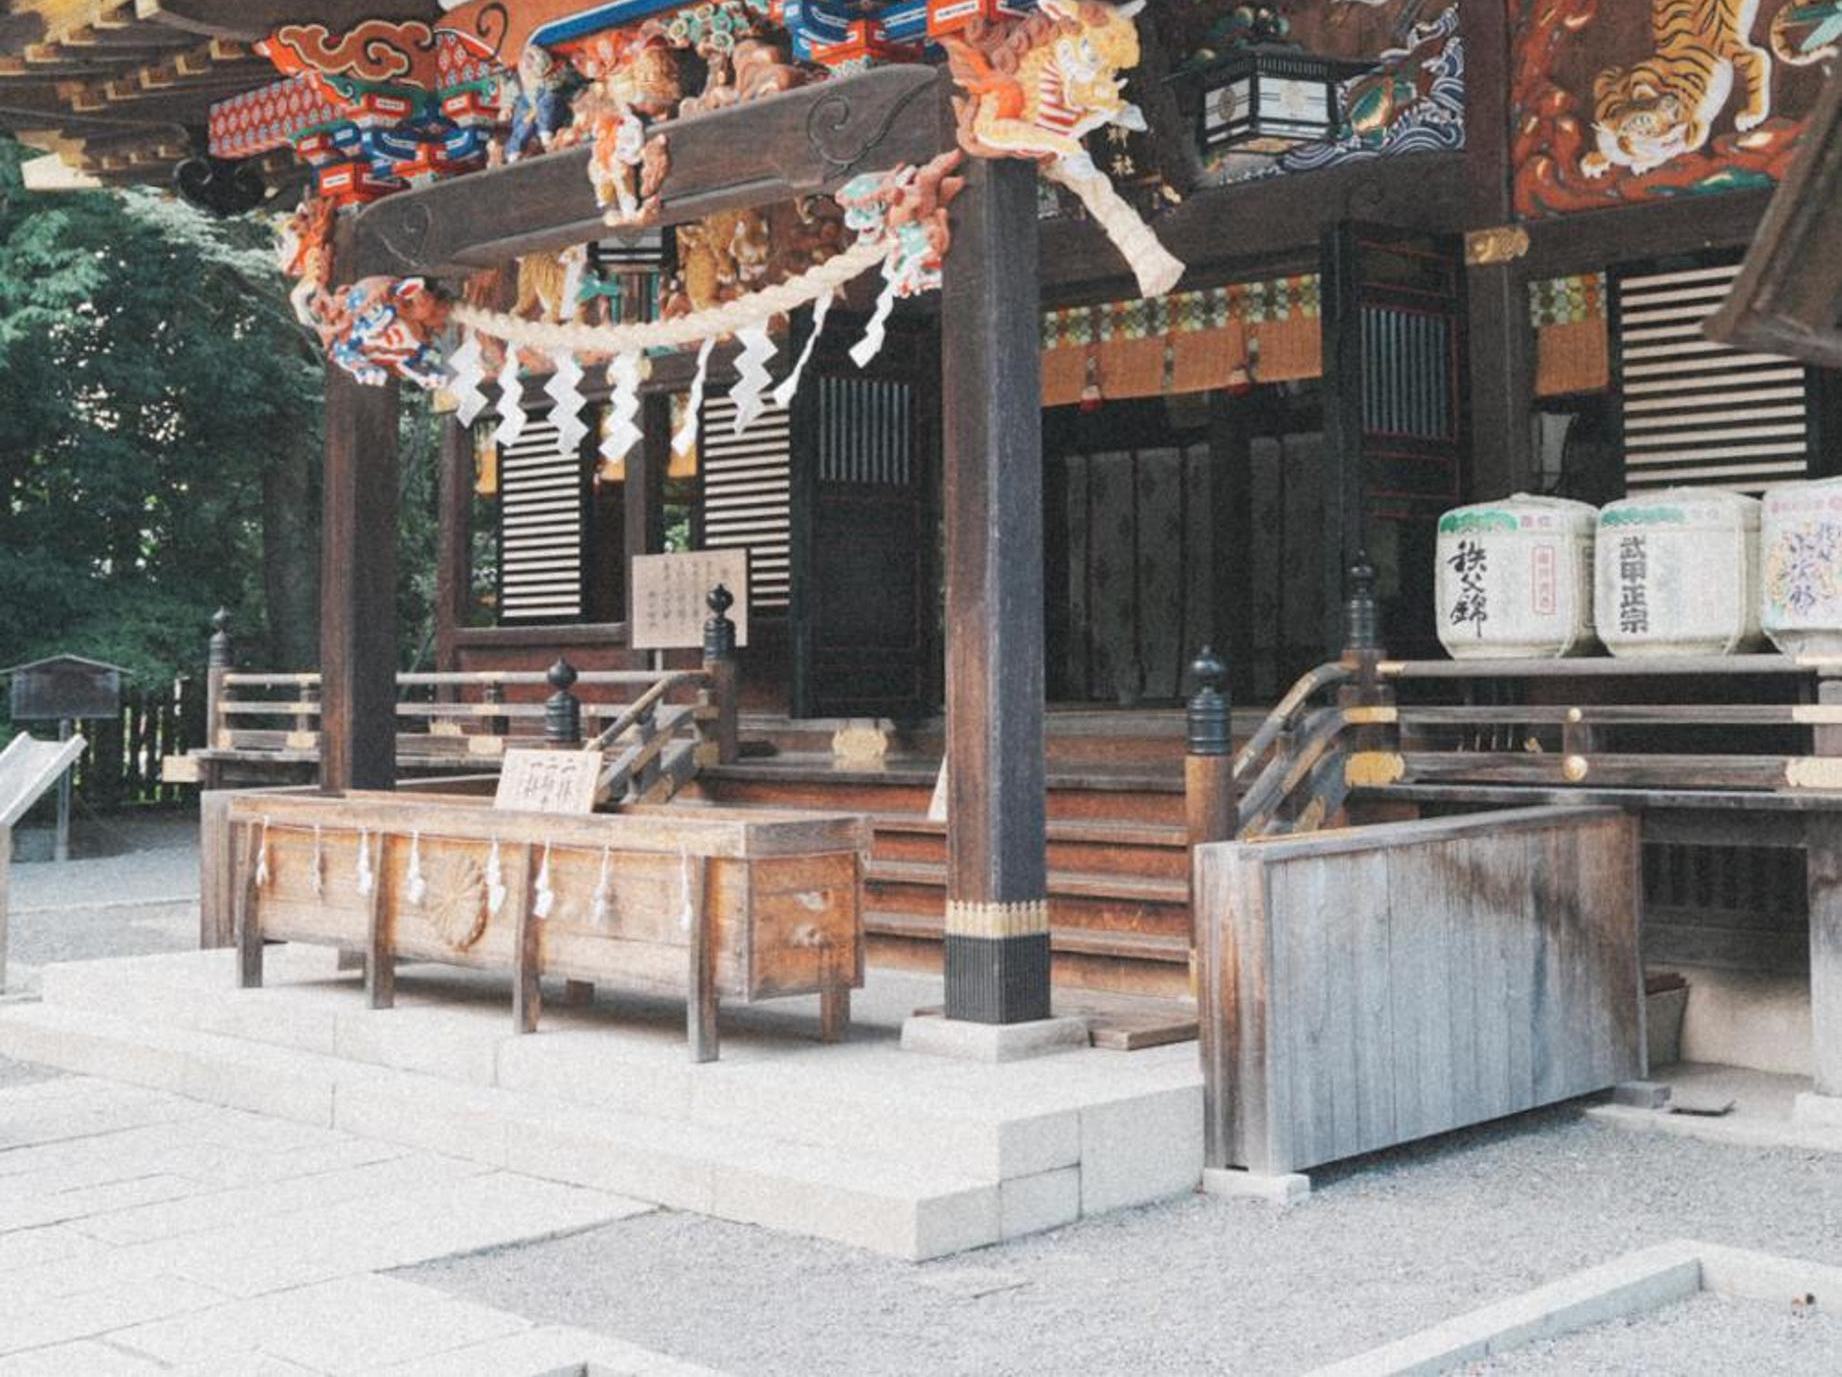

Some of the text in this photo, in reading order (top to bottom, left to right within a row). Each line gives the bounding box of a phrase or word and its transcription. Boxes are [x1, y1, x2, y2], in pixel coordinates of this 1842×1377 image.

[1447, 540, 1488, 638] 秩父錦
[1619, 535, 1649, 633] 武甲正宗
